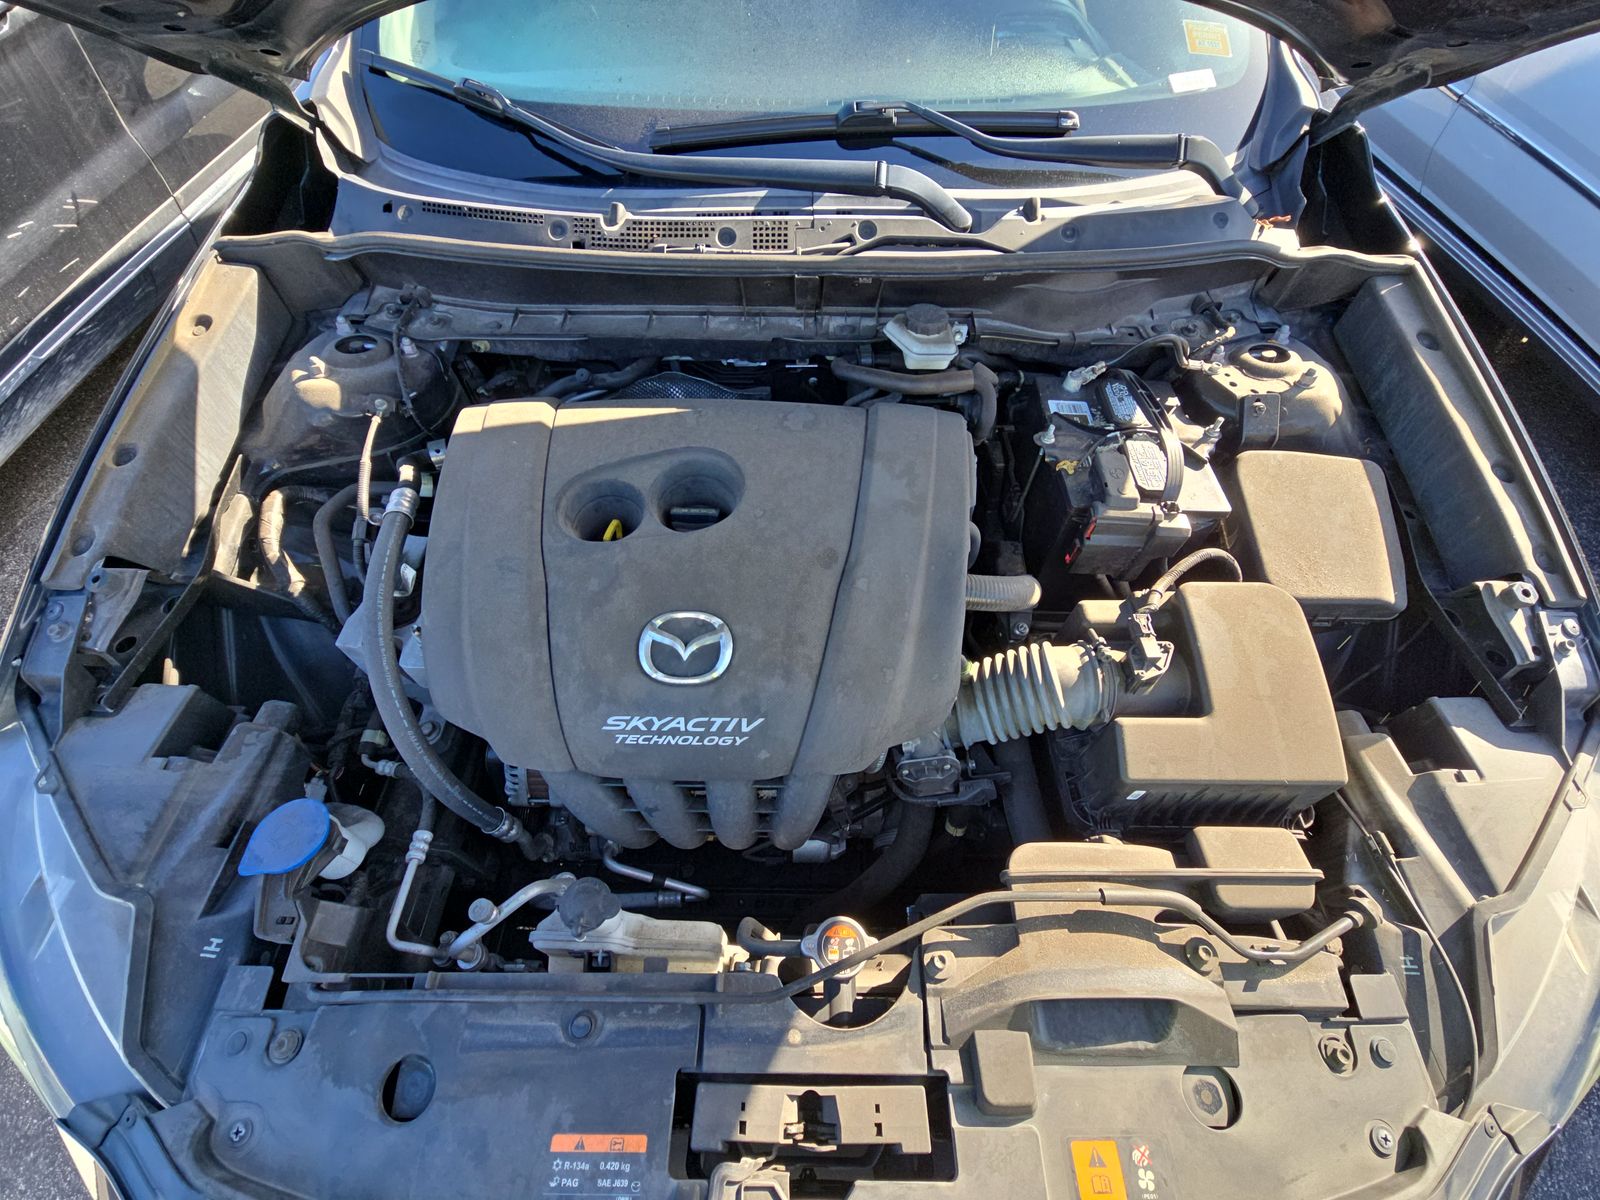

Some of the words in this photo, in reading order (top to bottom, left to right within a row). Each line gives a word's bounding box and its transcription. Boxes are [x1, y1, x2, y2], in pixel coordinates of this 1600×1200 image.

[601, 715, 766, 733] SKYACTIV
[615, 734, 750, 746] TECHNOLOGY
[563, 1161, 590, 1171] R-134a
[599, 1161, 619, 1171] 0.420
[620, 1161, 631, 1173] kg
[560, 1178, 579, 1188] PAG
[597, 1178, 611, 1188] SAE
[612, 1179, 629, 1188] J639
